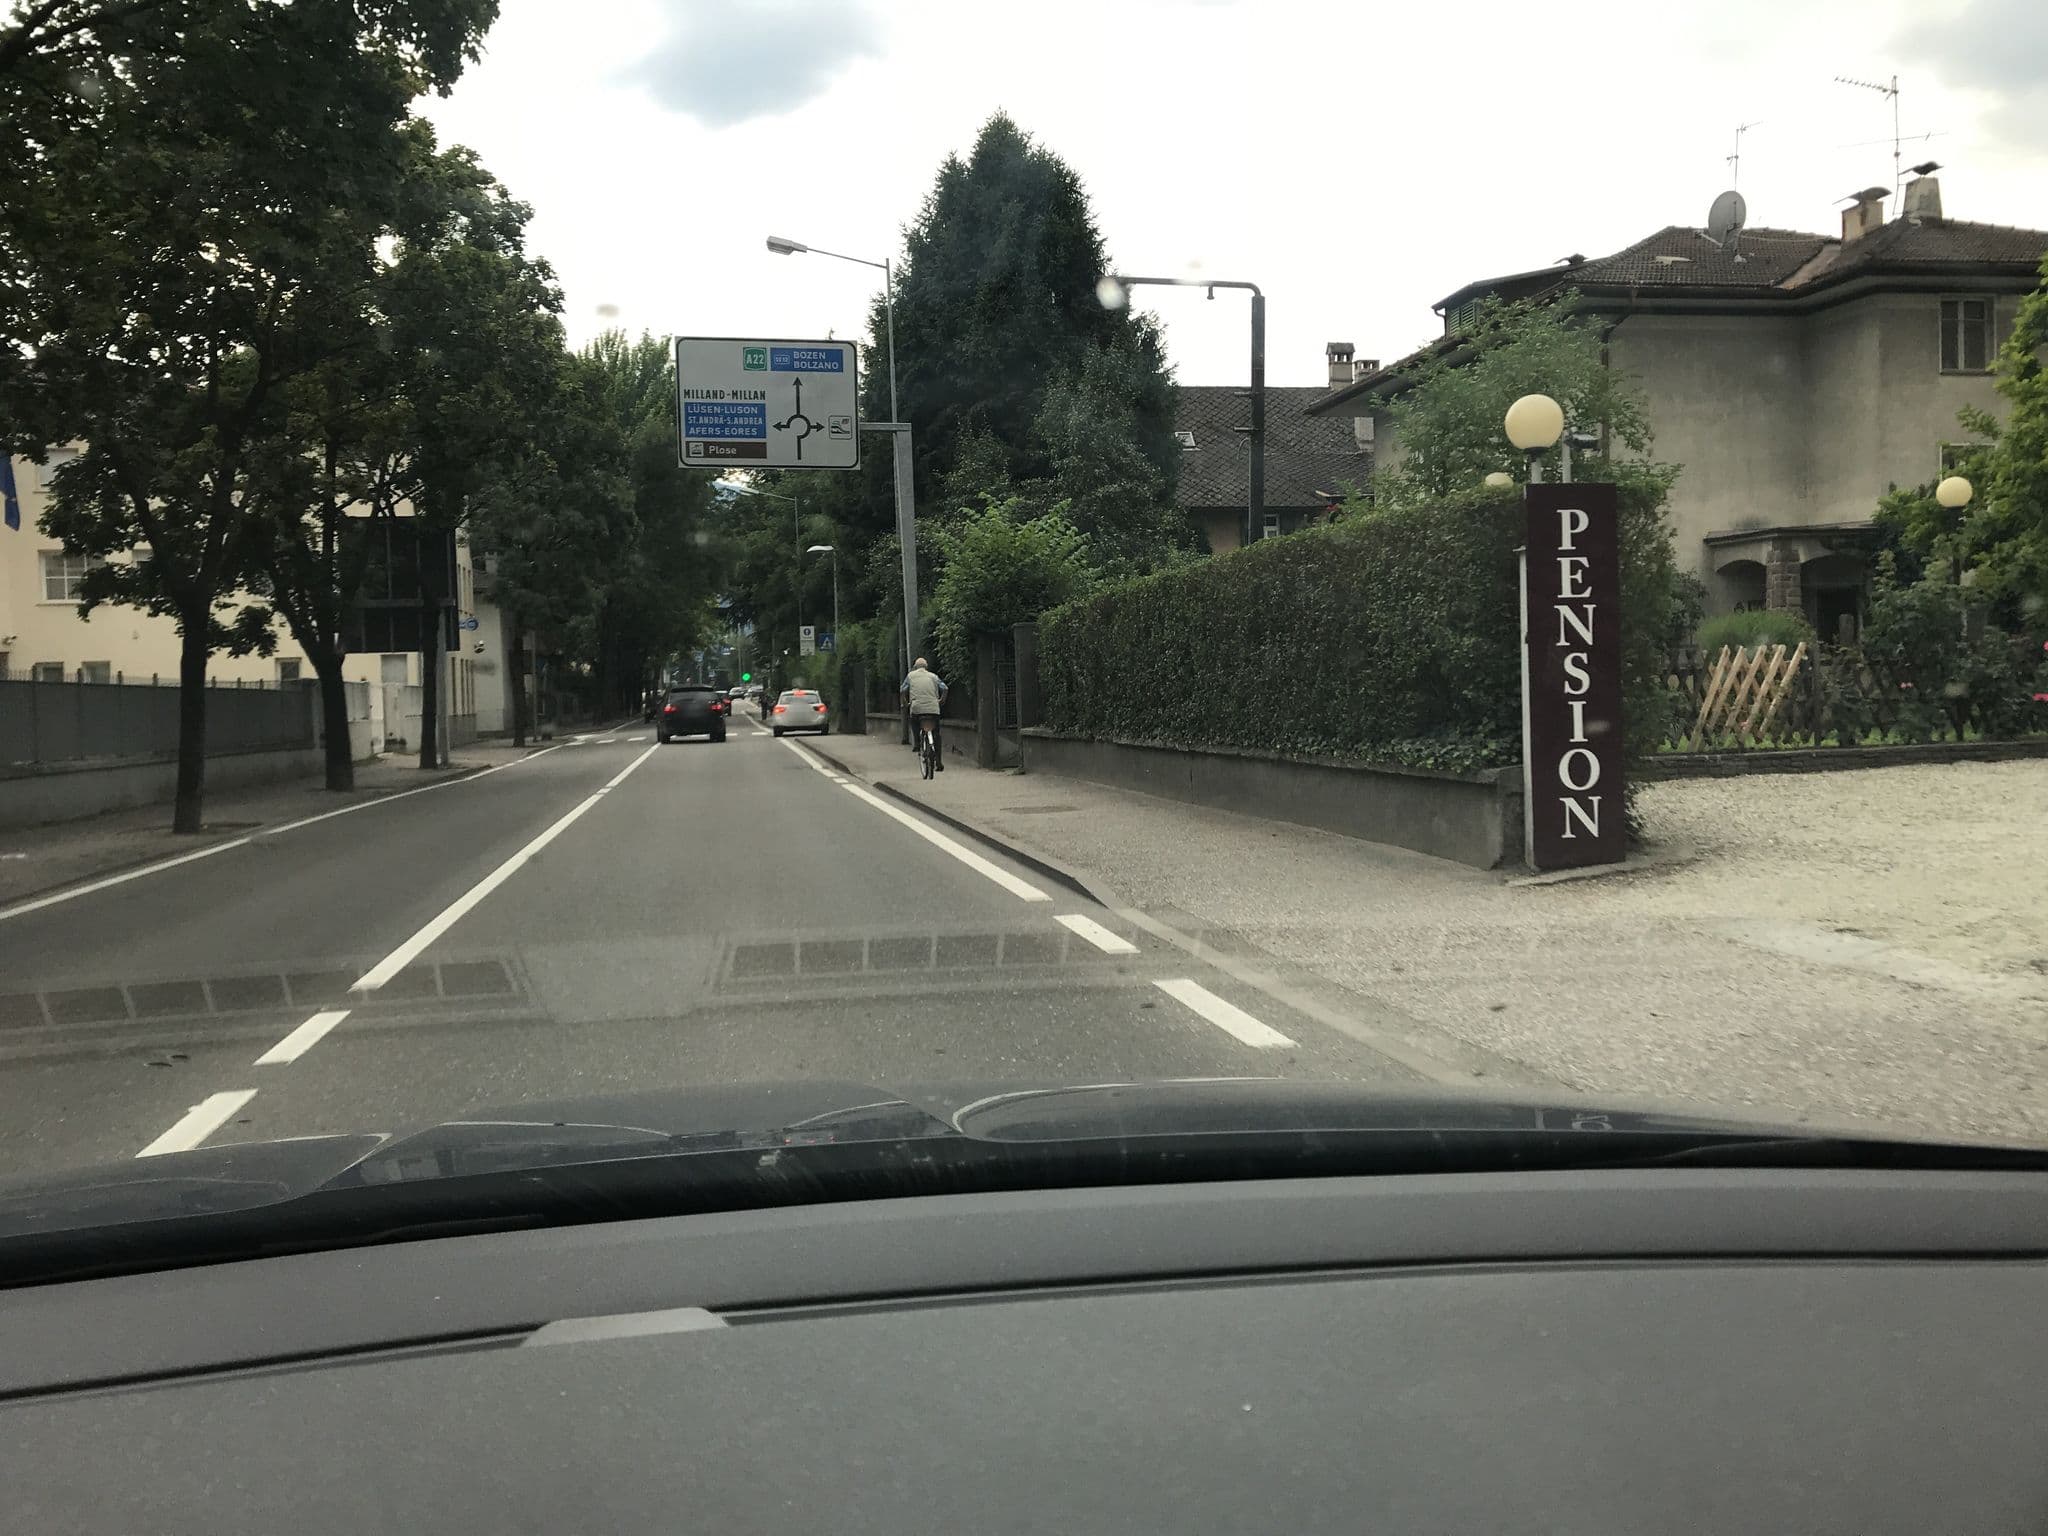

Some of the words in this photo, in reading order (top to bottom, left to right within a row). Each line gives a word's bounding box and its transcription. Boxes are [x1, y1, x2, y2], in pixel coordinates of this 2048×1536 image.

[746, 354, 764, 365] A22
[793, 351, 826, 360] BOZEN
[793, 361, 839, 370] BOLZANO
[689, 427, 758, 436] AFERS-EORES
[708, 445, 737, 455] Plose
[1553, 508, 1602, 839] PENSION
